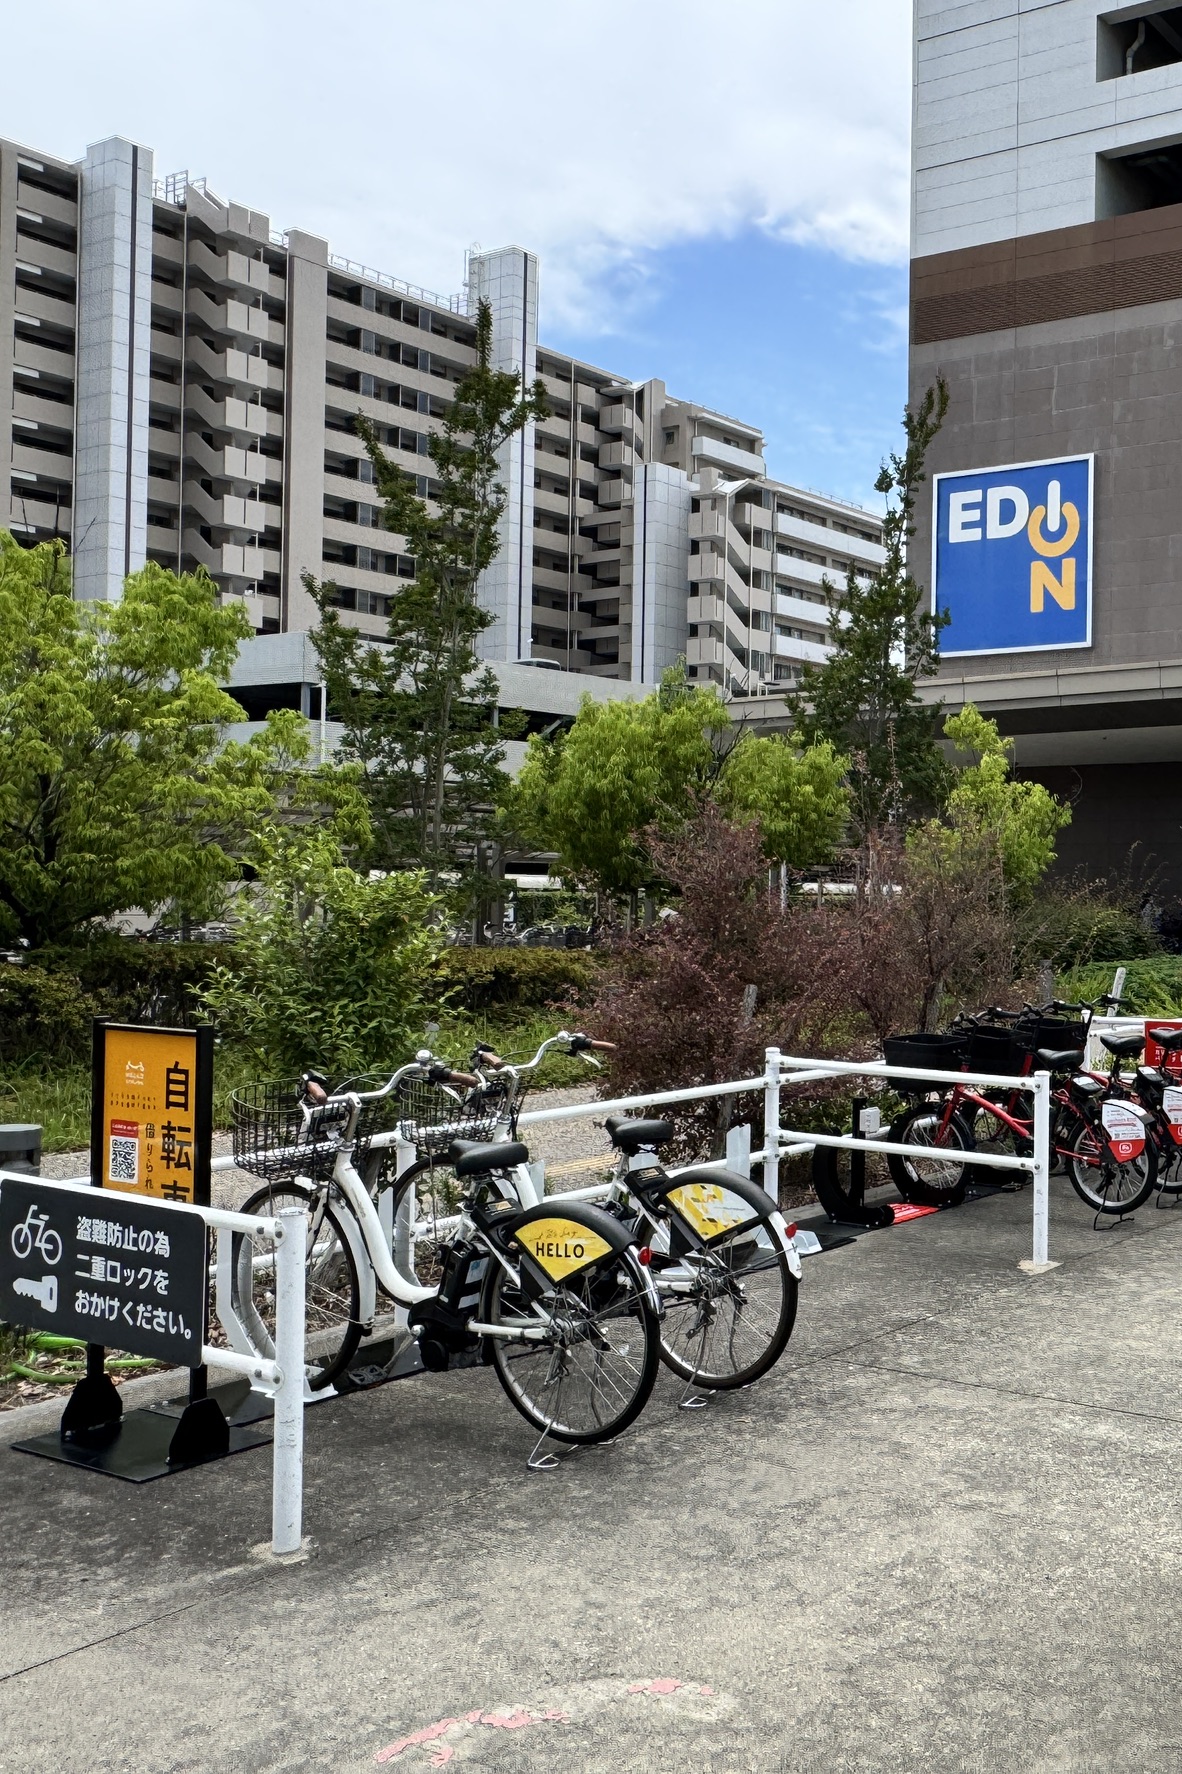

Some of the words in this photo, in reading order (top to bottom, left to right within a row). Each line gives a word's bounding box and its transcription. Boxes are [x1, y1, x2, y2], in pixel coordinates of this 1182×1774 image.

[76, 1215, 171, 1258] 盗難防止の為
[535, 1241, 585, 1258] HELLO
[74, 1253, 169, 1295] 二重ロックを
[74, 1289, 192, 1340] おかけください。
